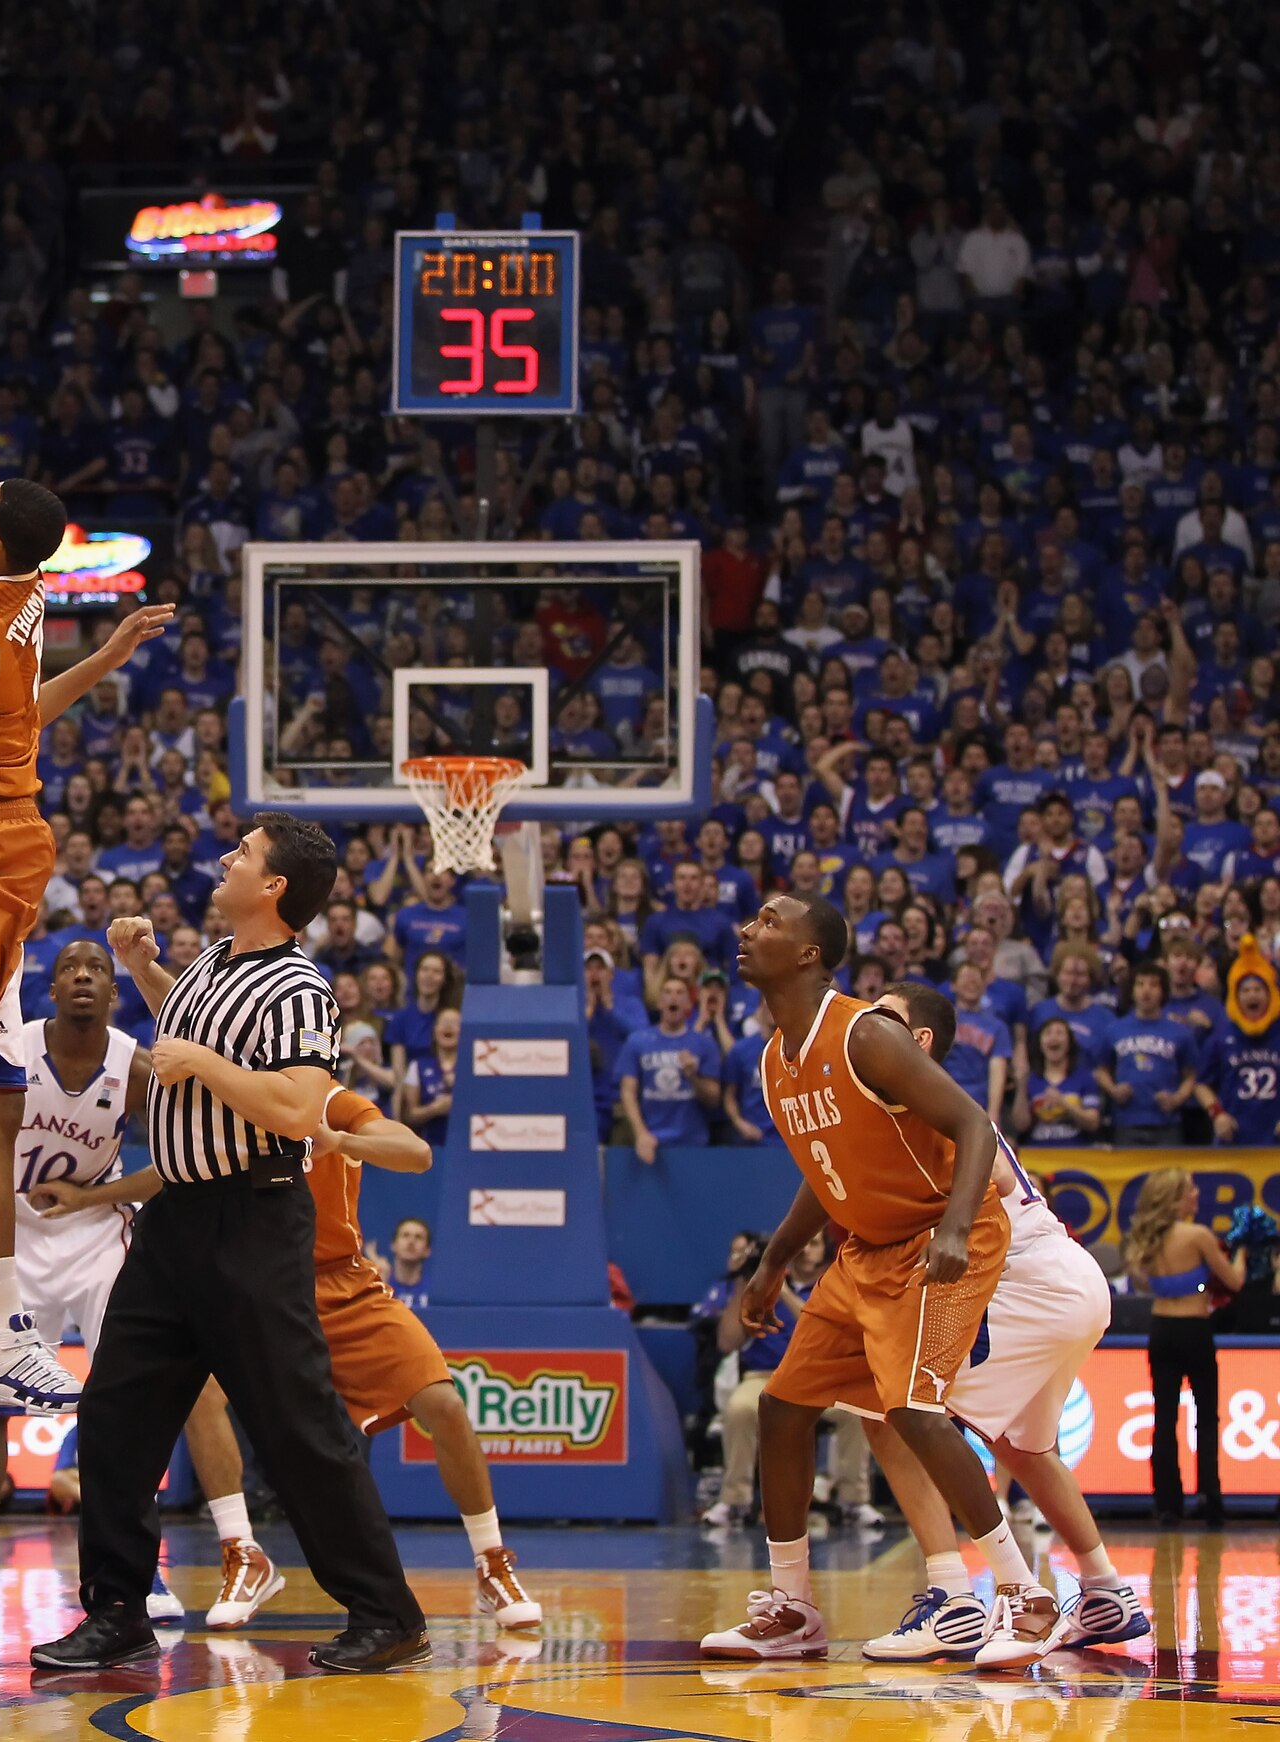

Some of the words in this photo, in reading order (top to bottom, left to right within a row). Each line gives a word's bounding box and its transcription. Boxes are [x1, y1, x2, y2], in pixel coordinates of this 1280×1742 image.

[422, 253, 554, 297] 20:00
[439, 308, 539, 394] 35
[1237, 1067, 1277, 1100] 32
[20, 1112, 105, 1151] ANSAS
[779, 1086, 842, 1136] TEXAS
[810, 1140, 847, 1201] 3
[480, 1439, 511, 1455] UTO
